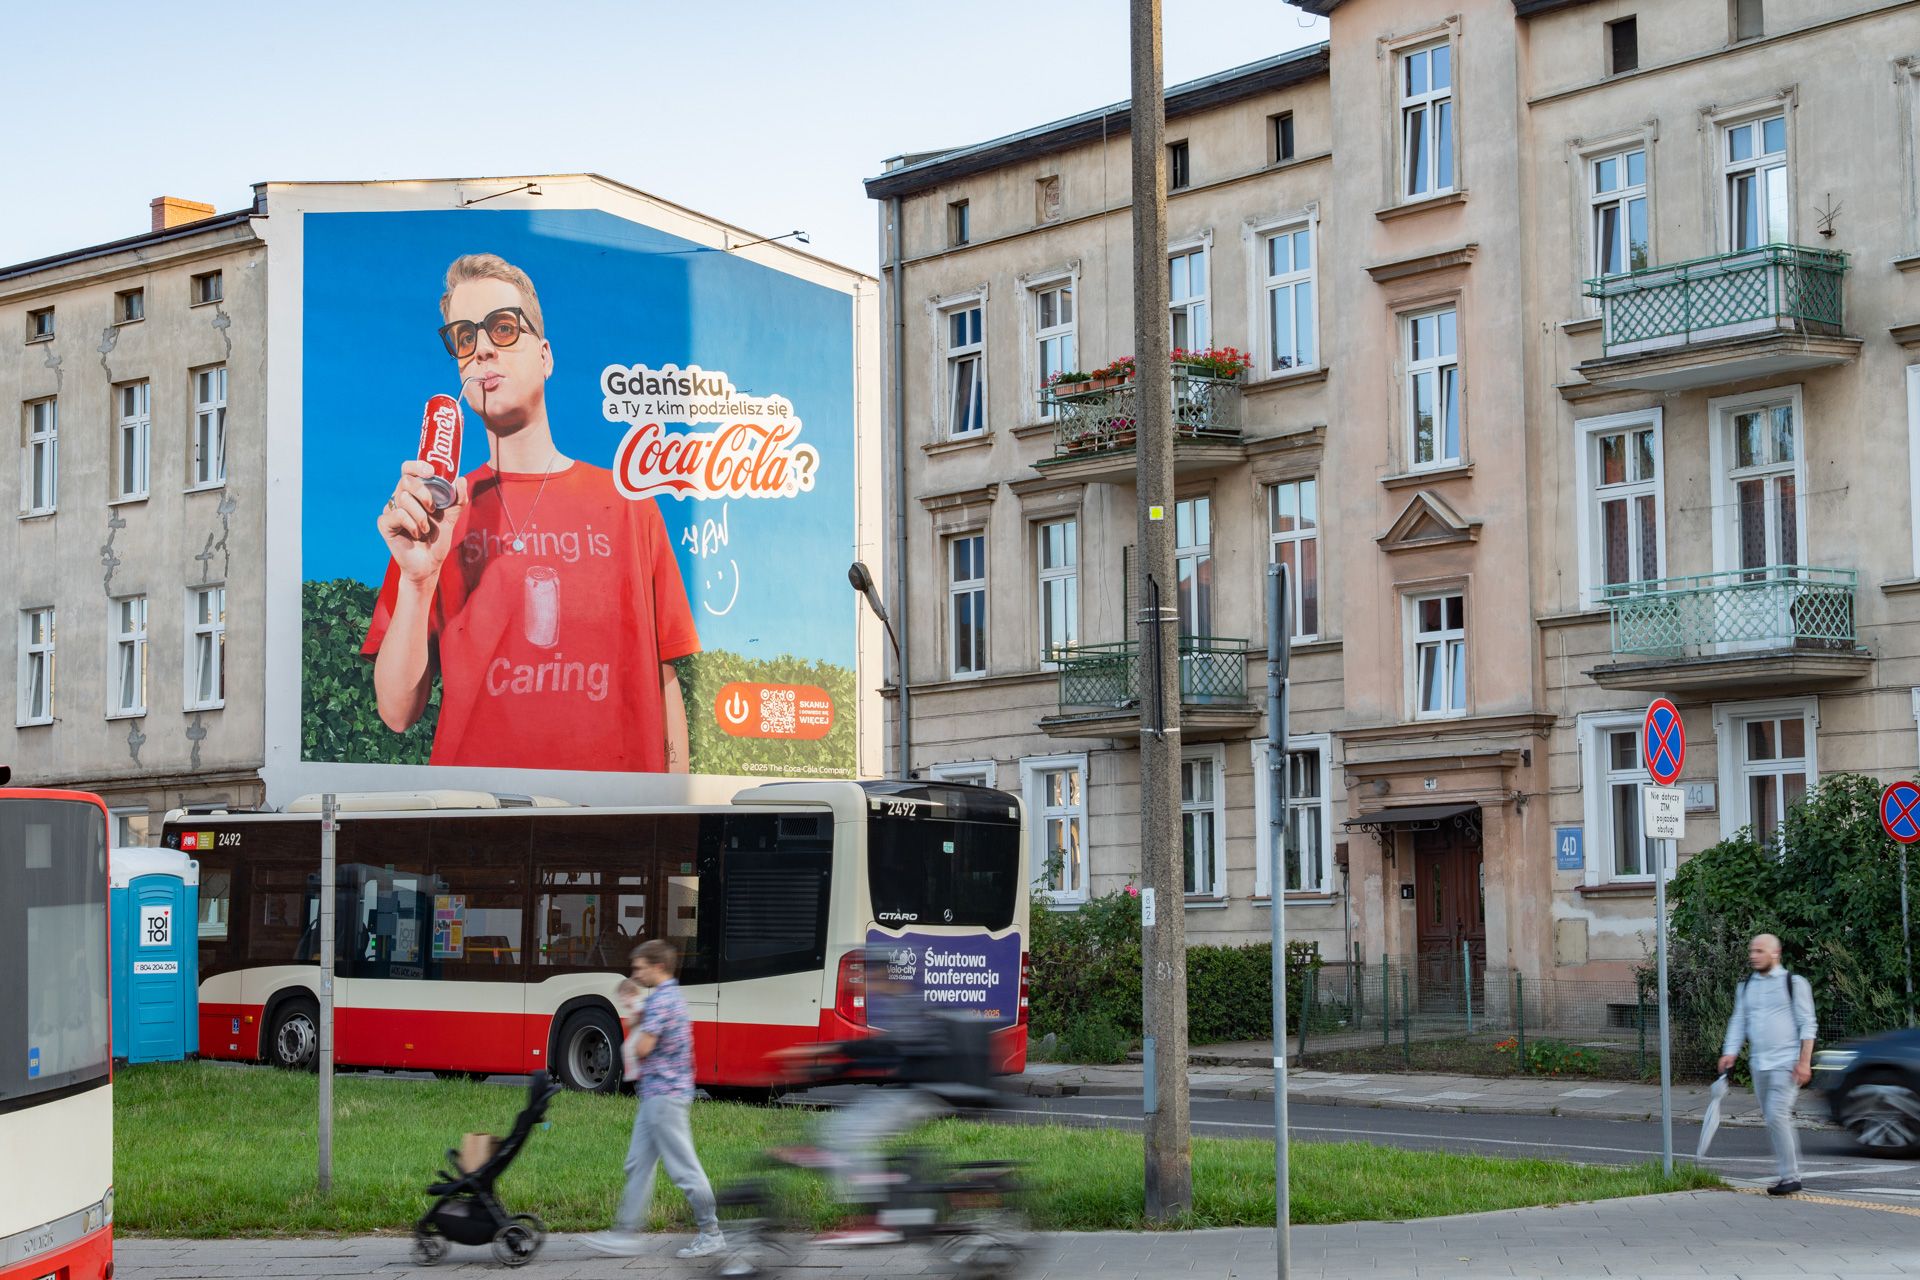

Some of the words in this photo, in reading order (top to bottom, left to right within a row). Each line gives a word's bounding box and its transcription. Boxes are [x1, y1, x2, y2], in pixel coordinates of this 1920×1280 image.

[607, 371, 730, 400] Gdańsku,
[609, 403, 618, 415] a
[622, 400, 640, 417] Ty
[645, 403, 653, 415] z
[657, 400, 684, 415] kim
[689, 401, 763, 418] podzielisz
[767, 402, 788, 418] się
[426, 405, 457, 472] Janek
[463, 523, 581, 564] Sharing
[586, 523, 612, 558] is
[486, 652, 610, 702] Caring
[799, 700, 829, 709] SKANUJ
[799, 716, 829, 725] WIĘCEJ
[750, 763, 768, 772] 2025
[770, 764, 783, 772] The
[784, 764, 818, 774] Coca-Cola
[820, 766, 851, 775] Company
[1650, 791, 1660, 801] Nie
[1661, 792, 1680, 803] dotyczy
[887, 800, 916, 817] 2492
[1660, 803, 1670, 812] ZTM
[218, 832, 241, 846] 2492
[1561, 836, 1577, 856] 4D
[1145, 895, 1151, 904] 8
[878, 912, 918, 921] CITARO
[1145, 911, 1151, 920] 2
[147, 916, 168, 929] TOI
[147, 929, 168, 942] TOI
[924, 946, 986, 968] Światowa
[140, 963, 152, 971] 804
[152, 963, 164, 971] 204
[164, 963, 176, 971] 204
[924, 968, 1000, 988] konferencja
[924, 989, 986, 1003] rowerowa
[984, 1009, 1000, 1018] 2025
